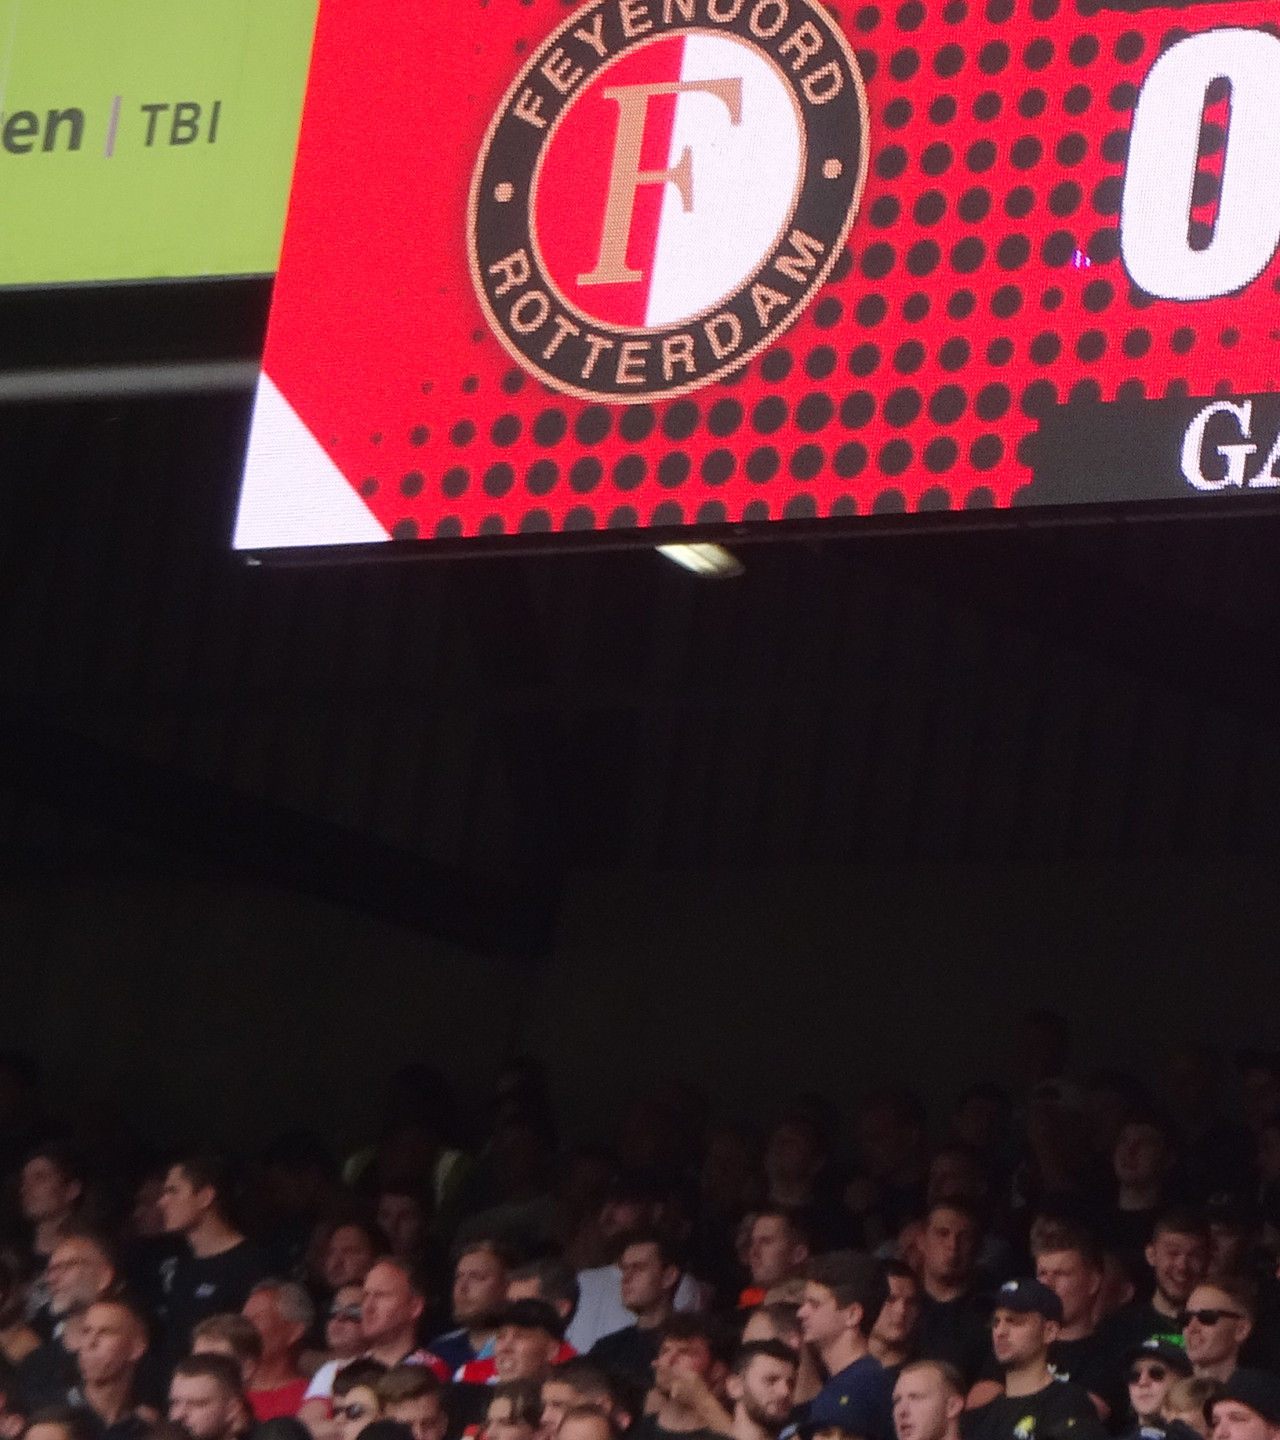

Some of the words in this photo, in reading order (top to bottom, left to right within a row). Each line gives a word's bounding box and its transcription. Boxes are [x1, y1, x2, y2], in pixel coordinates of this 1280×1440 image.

[141, 100, 221, 148] TBI
[576, 77, 743, 286] F
[489, 229, 825, 385] ROTTERDAM
